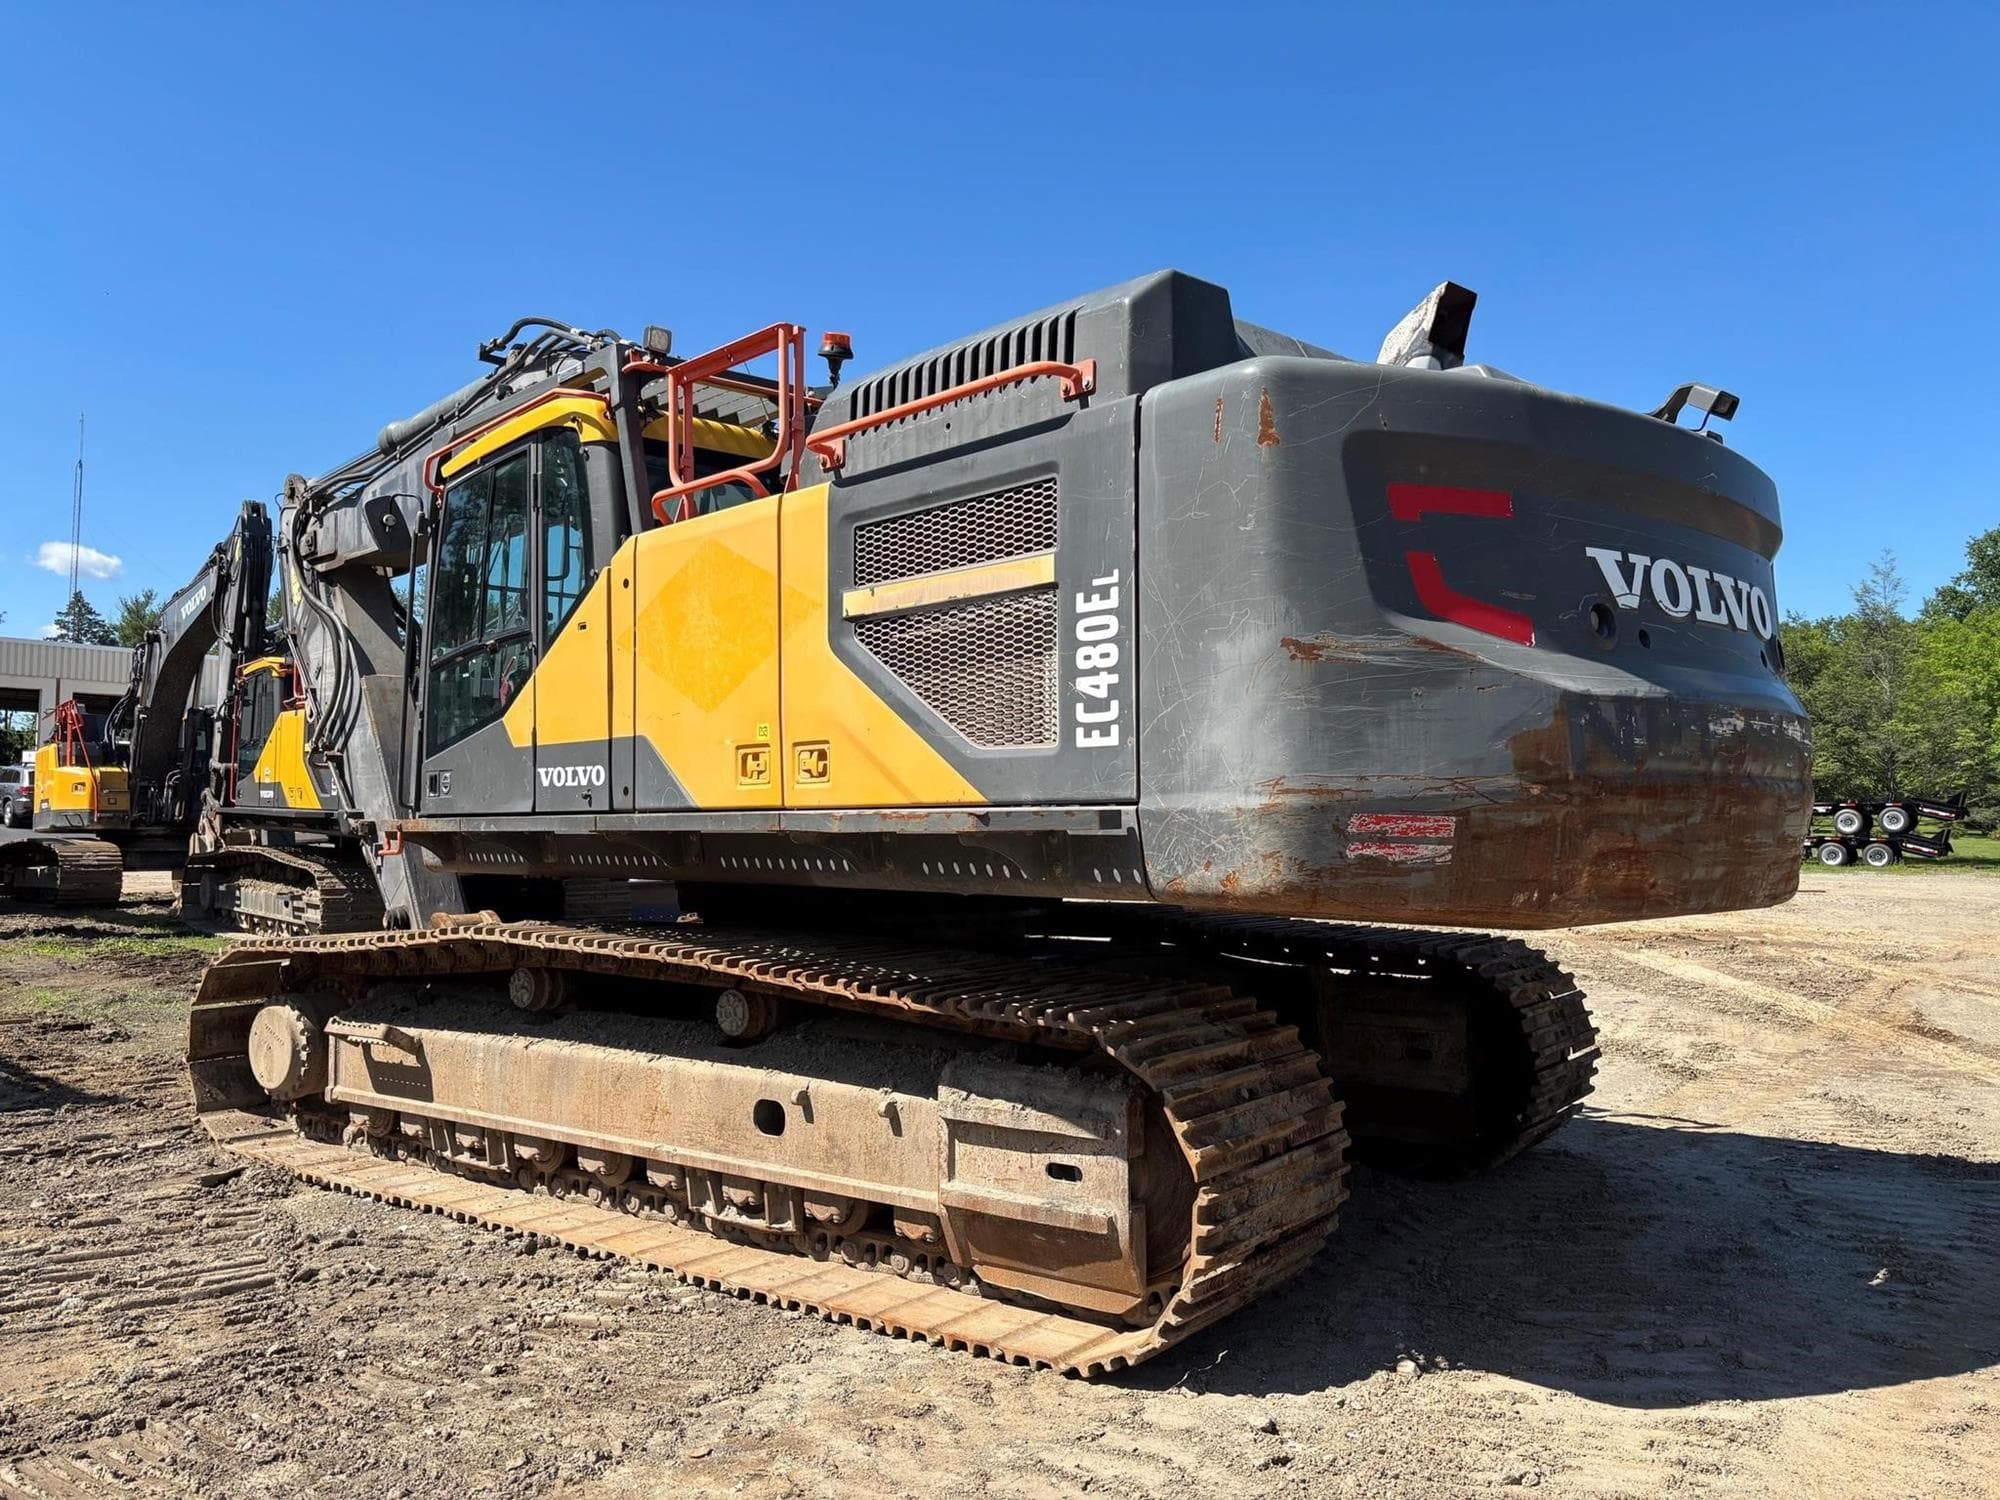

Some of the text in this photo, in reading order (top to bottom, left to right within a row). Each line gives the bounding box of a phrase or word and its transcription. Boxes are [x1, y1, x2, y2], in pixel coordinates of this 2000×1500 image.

[180, 585, 207, 620] VOLVO
[1585, 547, 1772, 640] VOLVO
[1075, 568, 1120, 748] EC480EL
[537, 765, 606, 787] VOLVO
